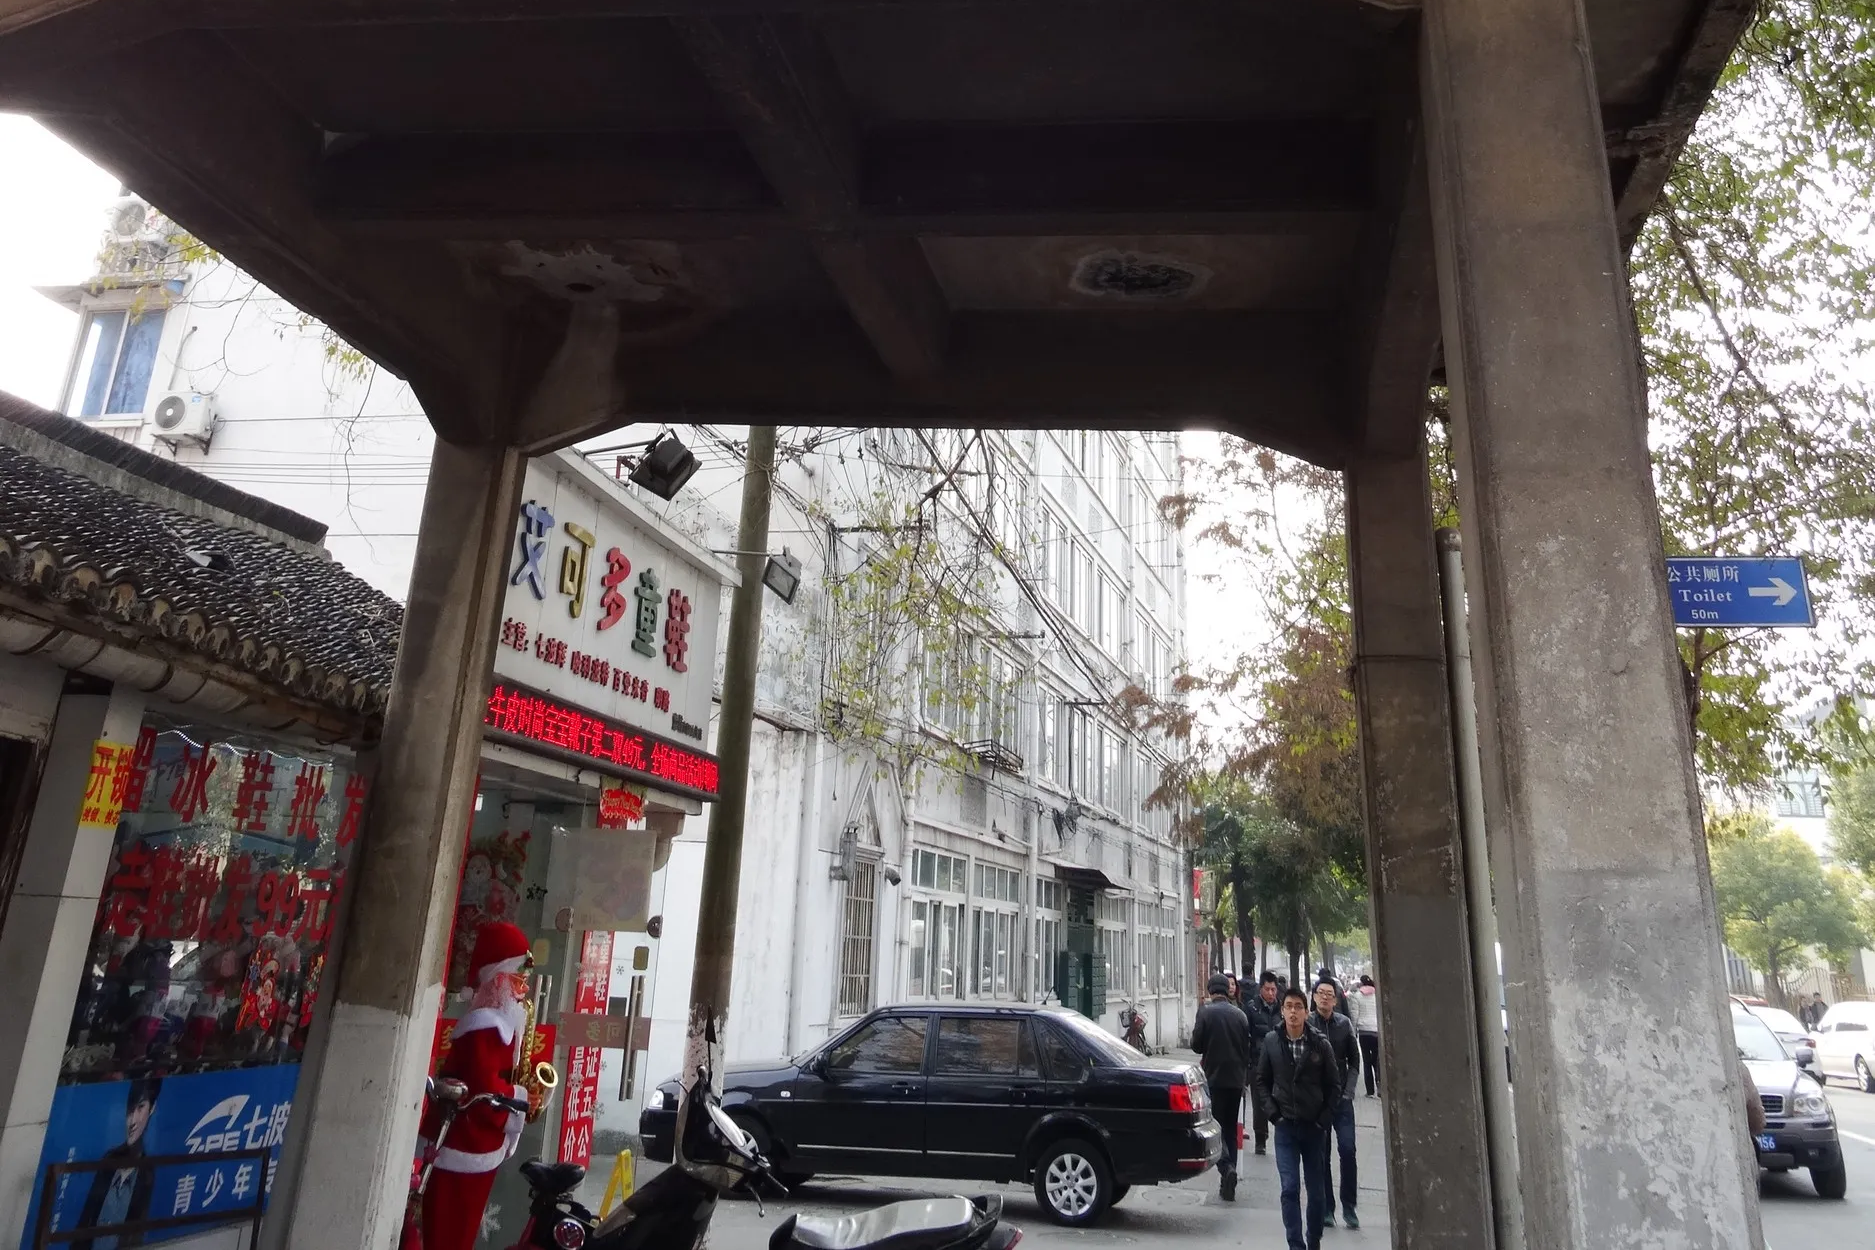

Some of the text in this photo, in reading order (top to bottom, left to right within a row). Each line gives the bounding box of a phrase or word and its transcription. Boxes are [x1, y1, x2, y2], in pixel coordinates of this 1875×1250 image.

[511, 500, 692, 673] 艾可多童鞋
[1667, 565, 1739, 583] 公共厕所
[1678, 588, 1733, 602] Toilet
[1691, 609, 1719, 620] 50m
[84, 746, 136, 806] 开锁
[243, 1101, 292, 1150] 七波
